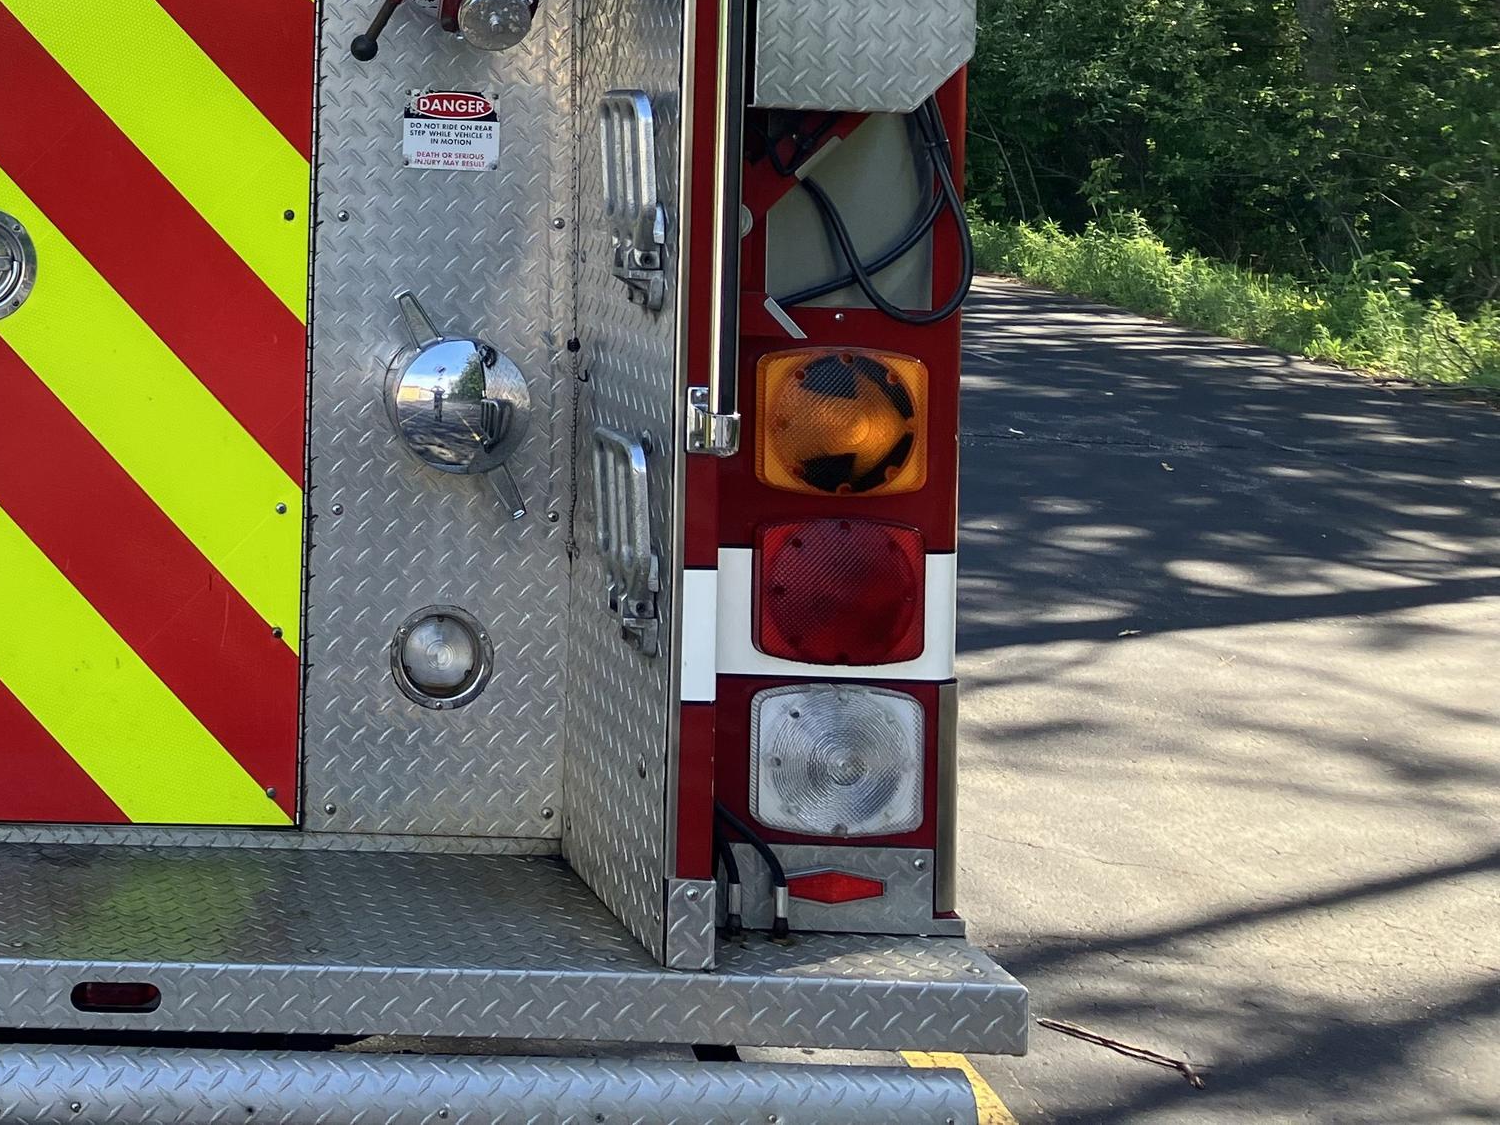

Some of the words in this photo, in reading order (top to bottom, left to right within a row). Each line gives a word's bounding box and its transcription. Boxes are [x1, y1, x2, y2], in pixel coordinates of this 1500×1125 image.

[419, 98, 485, 113] DANGER
[428, 130, 451, 138] WHILE
[454, 131, 483, 139] VEHICLE
[414, 158, 441, 166] INJURY
[442, 159, 460, 167] MAY
[461, 160, 485, 168] RESULT
